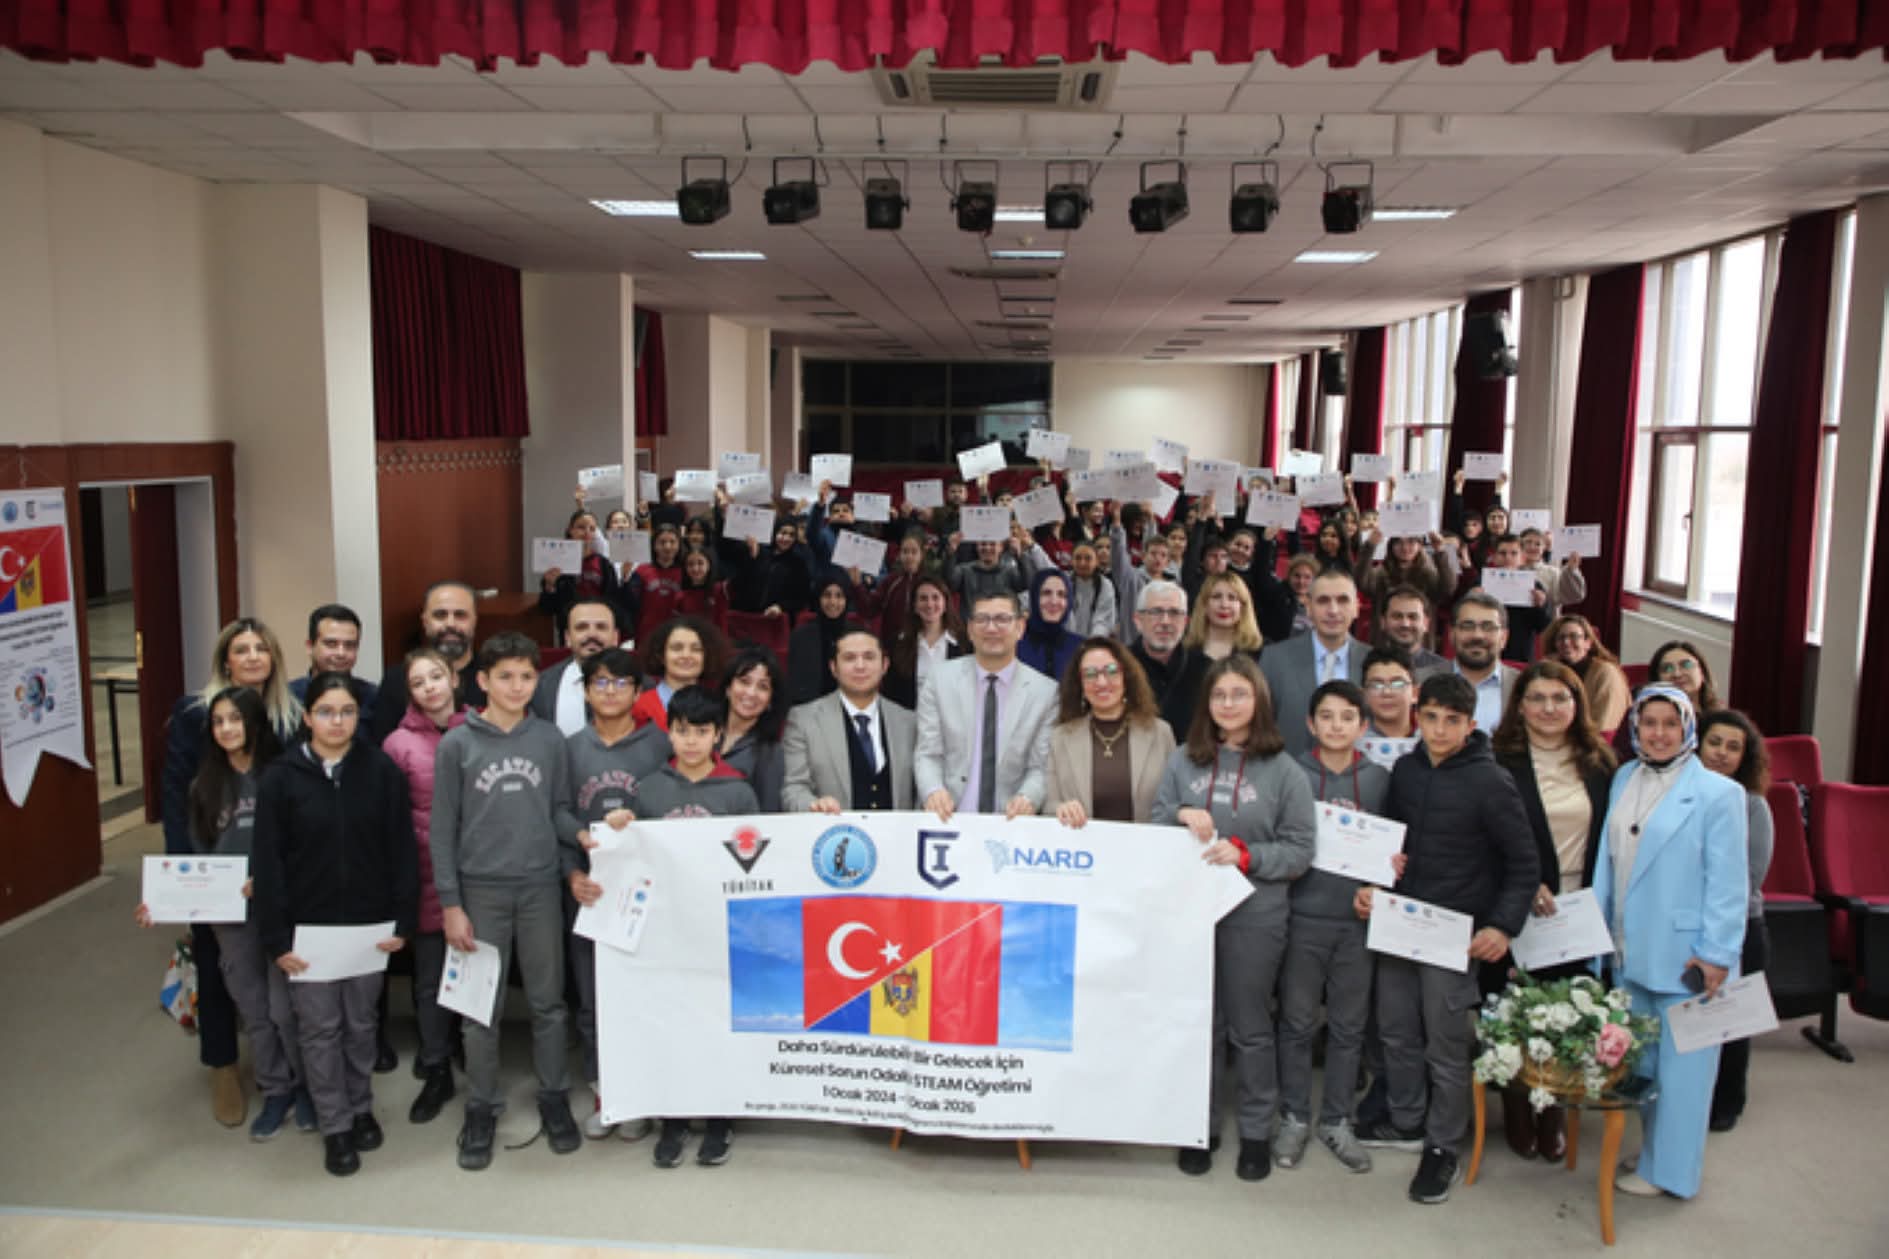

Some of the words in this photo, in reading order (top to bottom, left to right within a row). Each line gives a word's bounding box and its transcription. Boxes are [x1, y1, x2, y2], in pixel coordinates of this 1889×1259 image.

[1014, 847, 1093, 869] NARD
[722, 878, 774, 894] TÜBİTAK
[778, 1039, 818, 1053] Daha
[820, 1040, 911, 1060] Sürdürülebili
[934, 1053, 993, 1069] Gelecek
[770, 1062, 824, 1076] Küresel
[828, 1064, 868, 1080] Sorun
[870, 1068, 911, 1085] Odak
[914, 1074, 963, 1091] STEAM
[964, 1077, 1032, 1097] Öğretimi
[829, 1086, 862, 1100] Ocak
[865, 1089, 896, 1104] 2024
[944, 1099, 976, 1114] 2026
